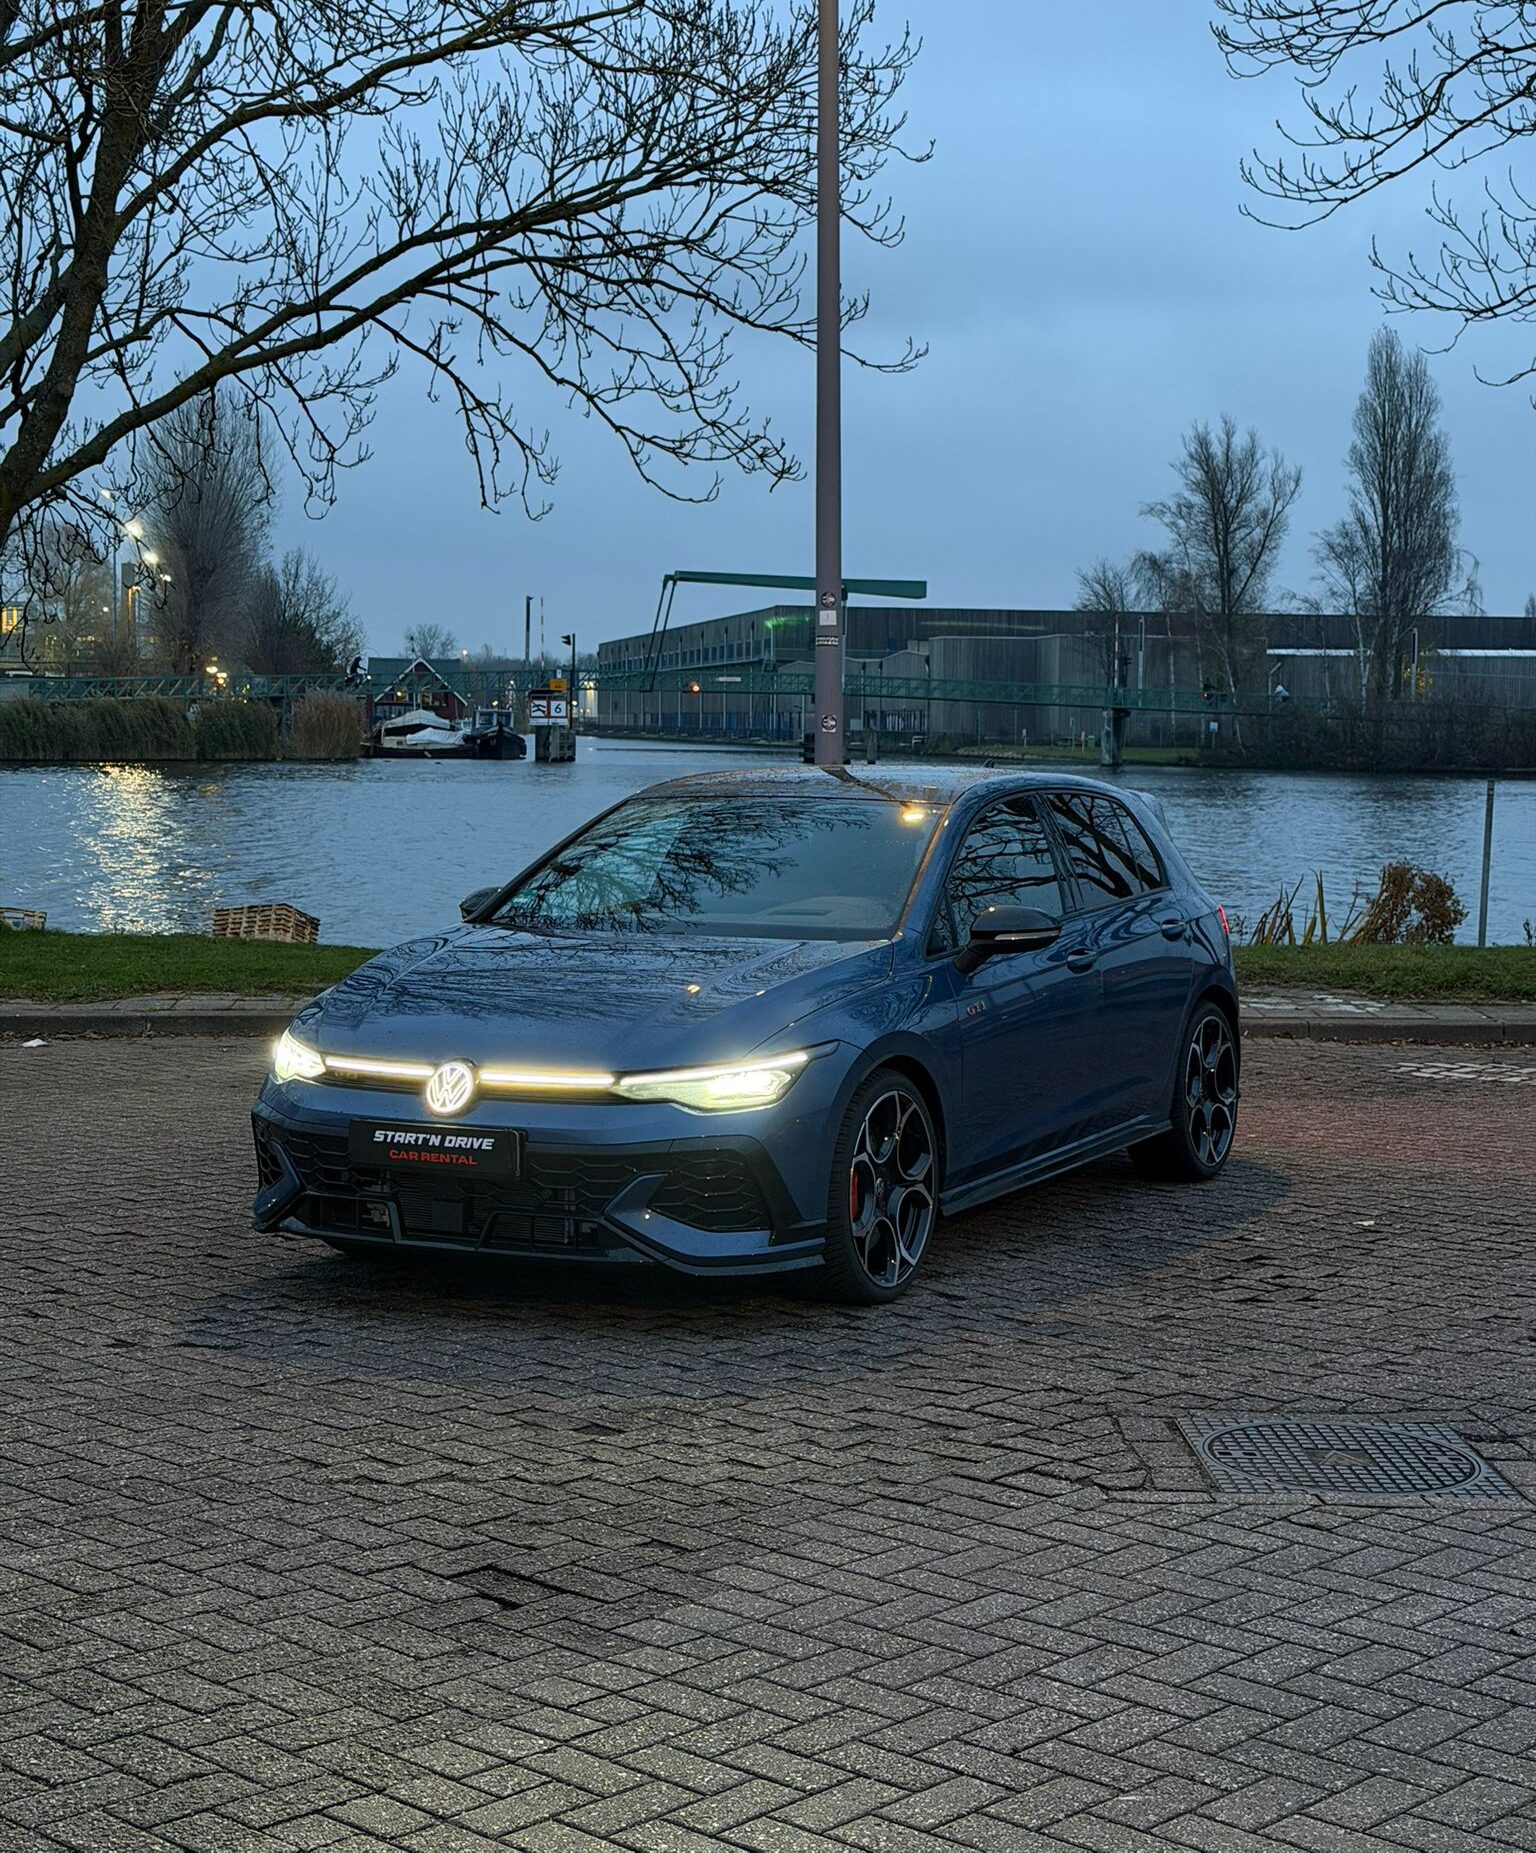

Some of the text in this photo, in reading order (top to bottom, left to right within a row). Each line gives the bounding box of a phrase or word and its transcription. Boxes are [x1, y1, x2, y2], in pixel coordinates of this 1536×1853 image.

[554, 703, 562, 714] 6
[373, 1130, 495, 1150] START'N DRIVE
[389, 1149, 478, 1165] CAR RENTAL
